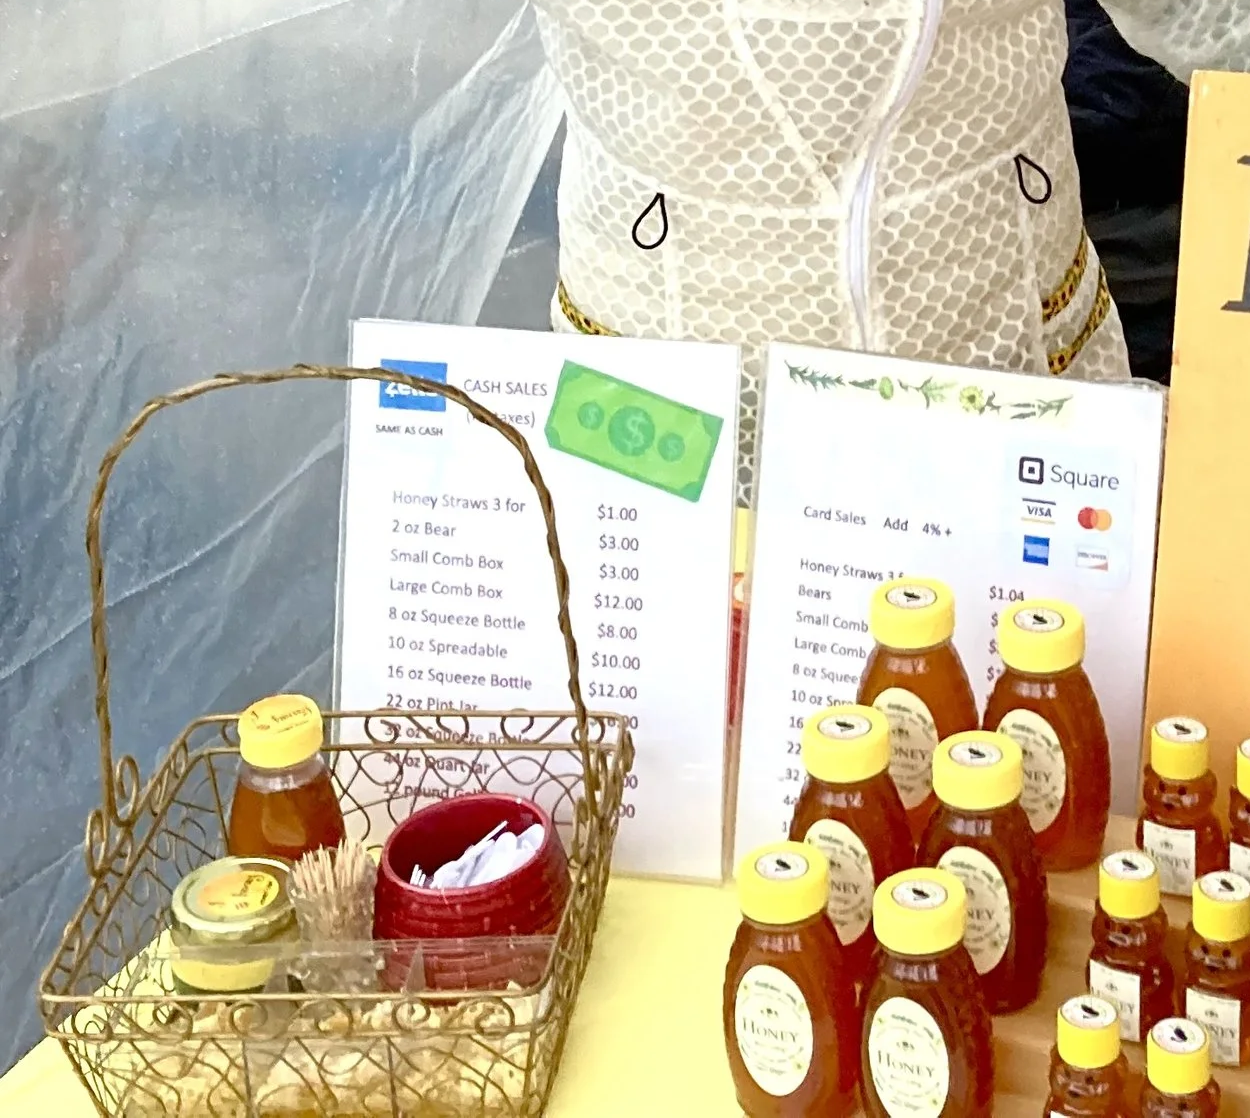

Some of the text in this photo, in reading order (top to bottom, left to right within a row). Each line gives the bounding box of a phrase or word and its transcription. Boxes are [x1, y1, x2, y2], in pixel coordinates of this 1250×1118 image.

[463, 378, 549, 397] CASH SALES
[375, 424, 444, 436] SAME AS CASH
[494, 411, 536, 428] axes)
[1050, 464, 1120, 491] Square
[392, 490, 639, 522] Honey Straws 3 for $1.00
[1026, 504, 1053, 518] VISA
[803, 506, 833, 522] Card
[835, 509, 867, 527] Sales
[883, 516, 909, 532] Add
[922, 522, 942, 537] 4%
[392, 519, 640, 552] 2 oz Bear $3.00
[390, 549, 640, 582] Small Comb Box $3.00
[800, 558, 840, 577] Honey
[843, 564, 884, 582] Straws
[389, 577, 644, 612] Large Comb Box $12.00
[798, 584, 1025, 602] Bears $1.04
[388, 607, 638, 641] 8 oz Squeeze Bottle $8.00
[796, 610, 869, 633] Small Comb
[388, 636, 641, 671] 10 oz Spreadable $10.00
[794, 636, 867, 659] Large Comb
[387, 665, 638, 700] 16 oz Squeeze Bottle $12.00
[803, 667, 817, 678] oz
[820, 668, 860, 684] Squee
[386, 693, 403, 707] 22
[406, 698, 422, 710] oz
[427, 697, 453, 711] Pint
[791, 689, 806, 703] 10
[809, 694, 823, 706] oz
[406, 727, 422, 739] oz
[789, 716, 804, 730] 16
[787, 741, 802, 755] 22
[405, 756, 421, 768] oz
[785, 767, 800, 782] 32
[742, 1017, 799, 1044] HONEY
[877, 1049, 935, 1079] HONEY
